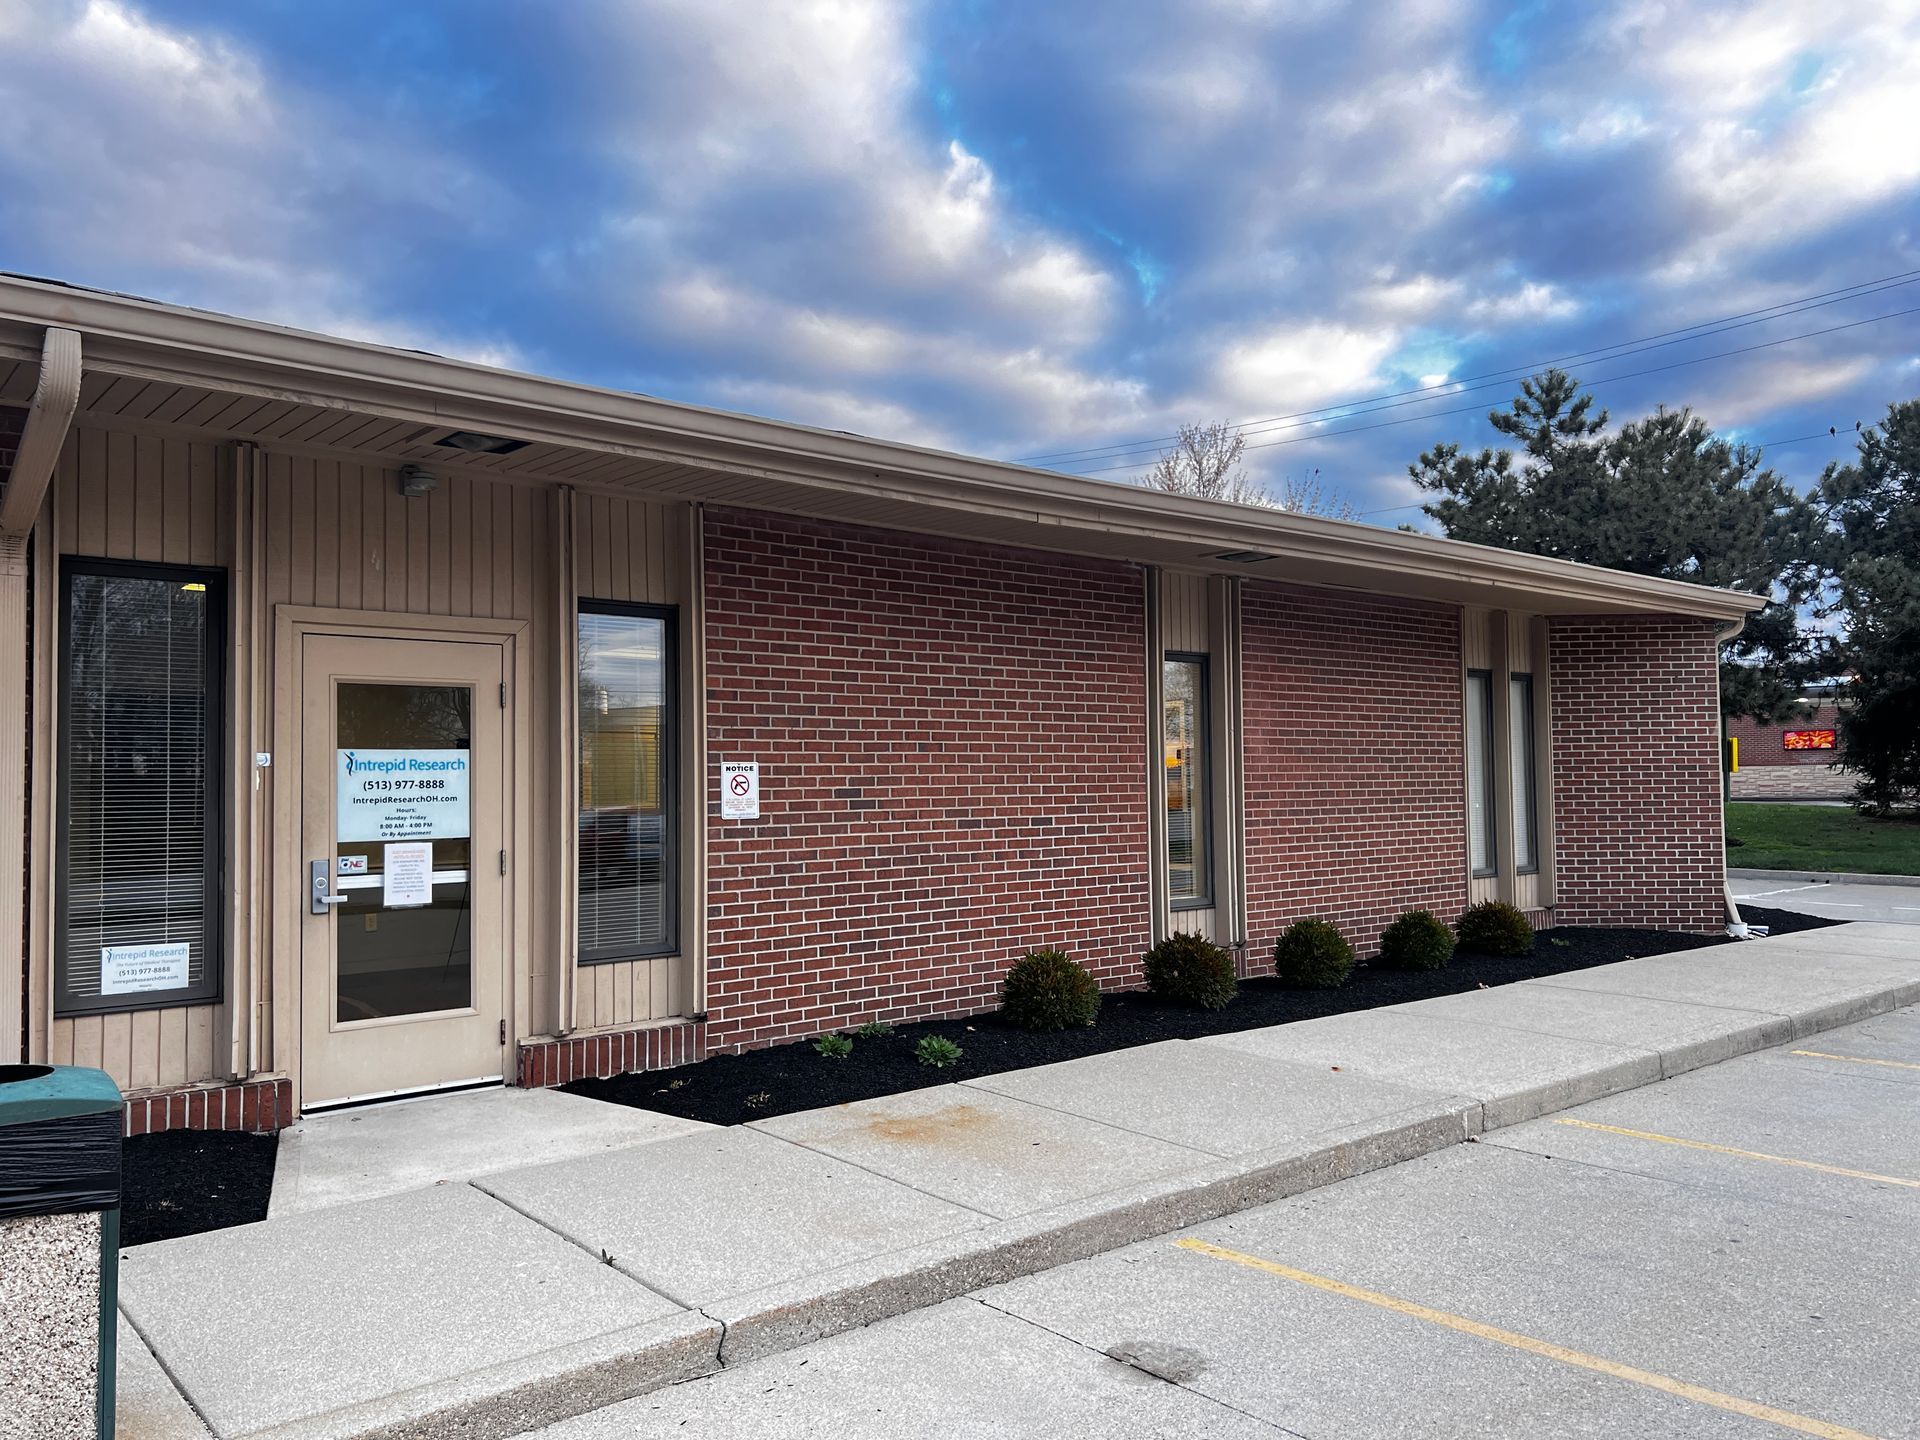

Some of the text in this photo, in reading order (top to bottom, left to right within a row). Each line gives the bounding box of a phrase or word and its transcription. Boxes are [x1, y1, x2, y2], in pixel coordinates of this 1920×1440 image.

[354, 758, 465, 774] Intrepid Research
[363, 779, 445, 791] (513) 977-8888
[353, 795, 458, 805] IntrepidResearchOH.com
[112, 947, 188, 960] Intrepid Research
[118, 966, 171, 977] (513) 977-8888
